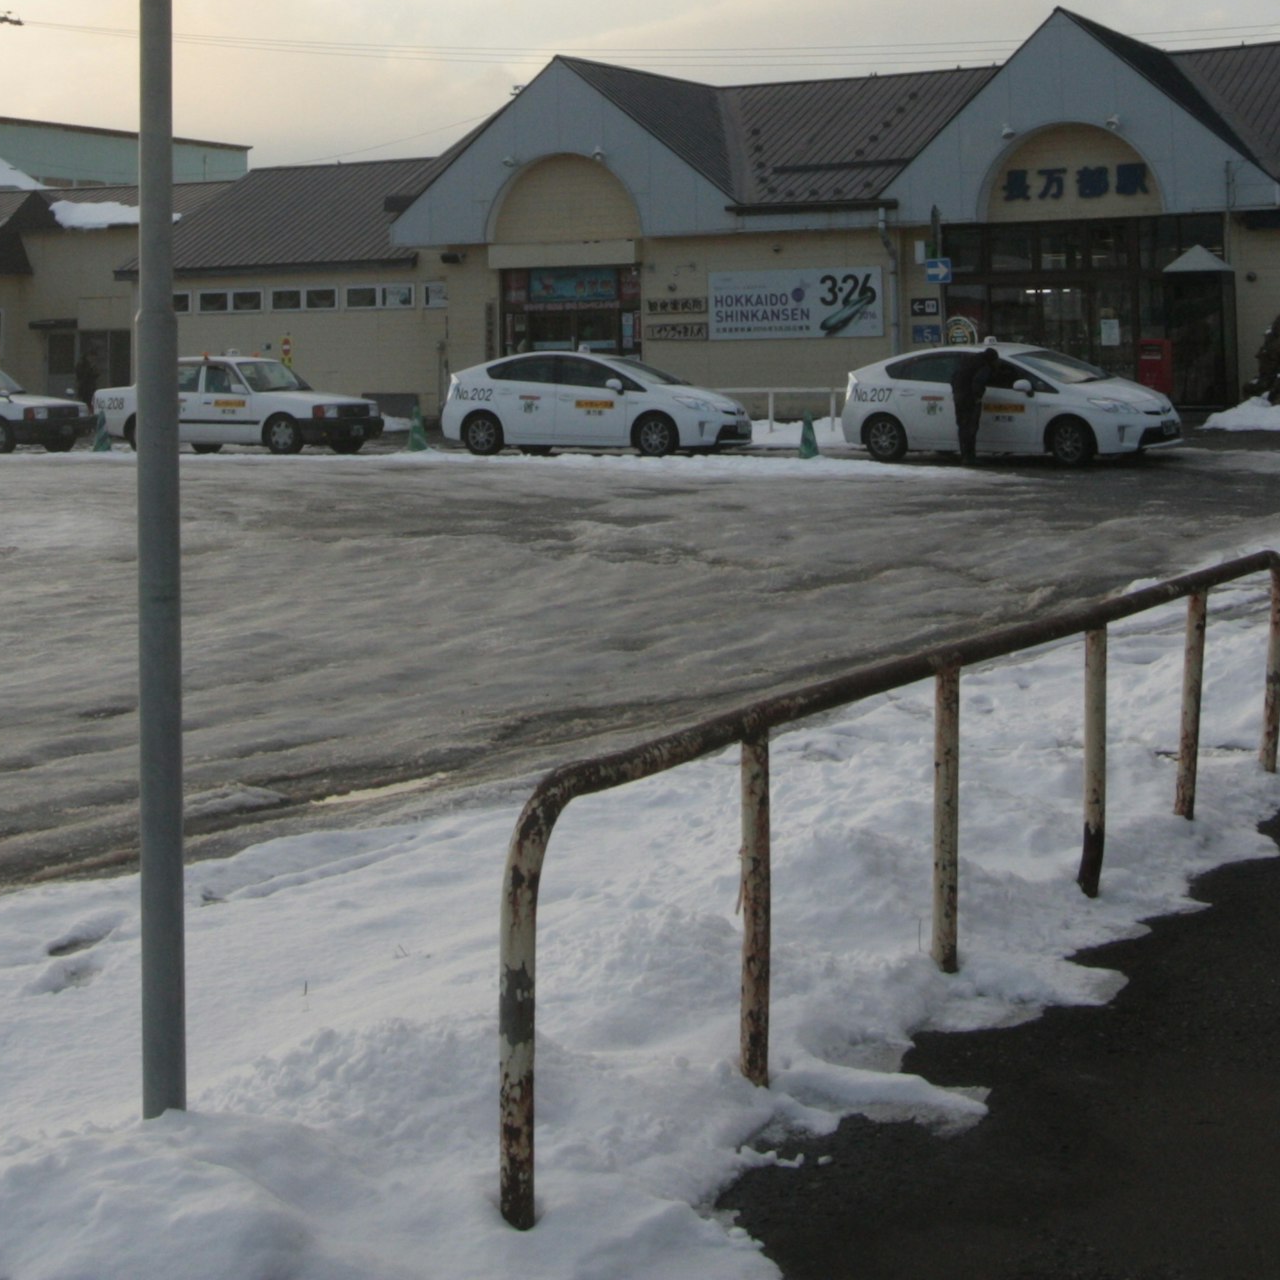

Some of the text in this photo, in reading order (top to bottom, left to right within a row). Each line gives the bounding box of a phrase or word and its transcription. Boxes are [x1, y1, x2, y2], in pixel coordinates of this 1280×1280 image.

[1003, 163, 1149, 201] 長万部駅
[714, 293, 788, 308] HOKKAIDO
[715, 308, 810, 323] SHINKANSEN
[923, 329, 932, 341] 5
[455, 387, 493, 401] No.202
[854, 388, 892, 402] No.207
[96, 397, 125, 410] No.208
